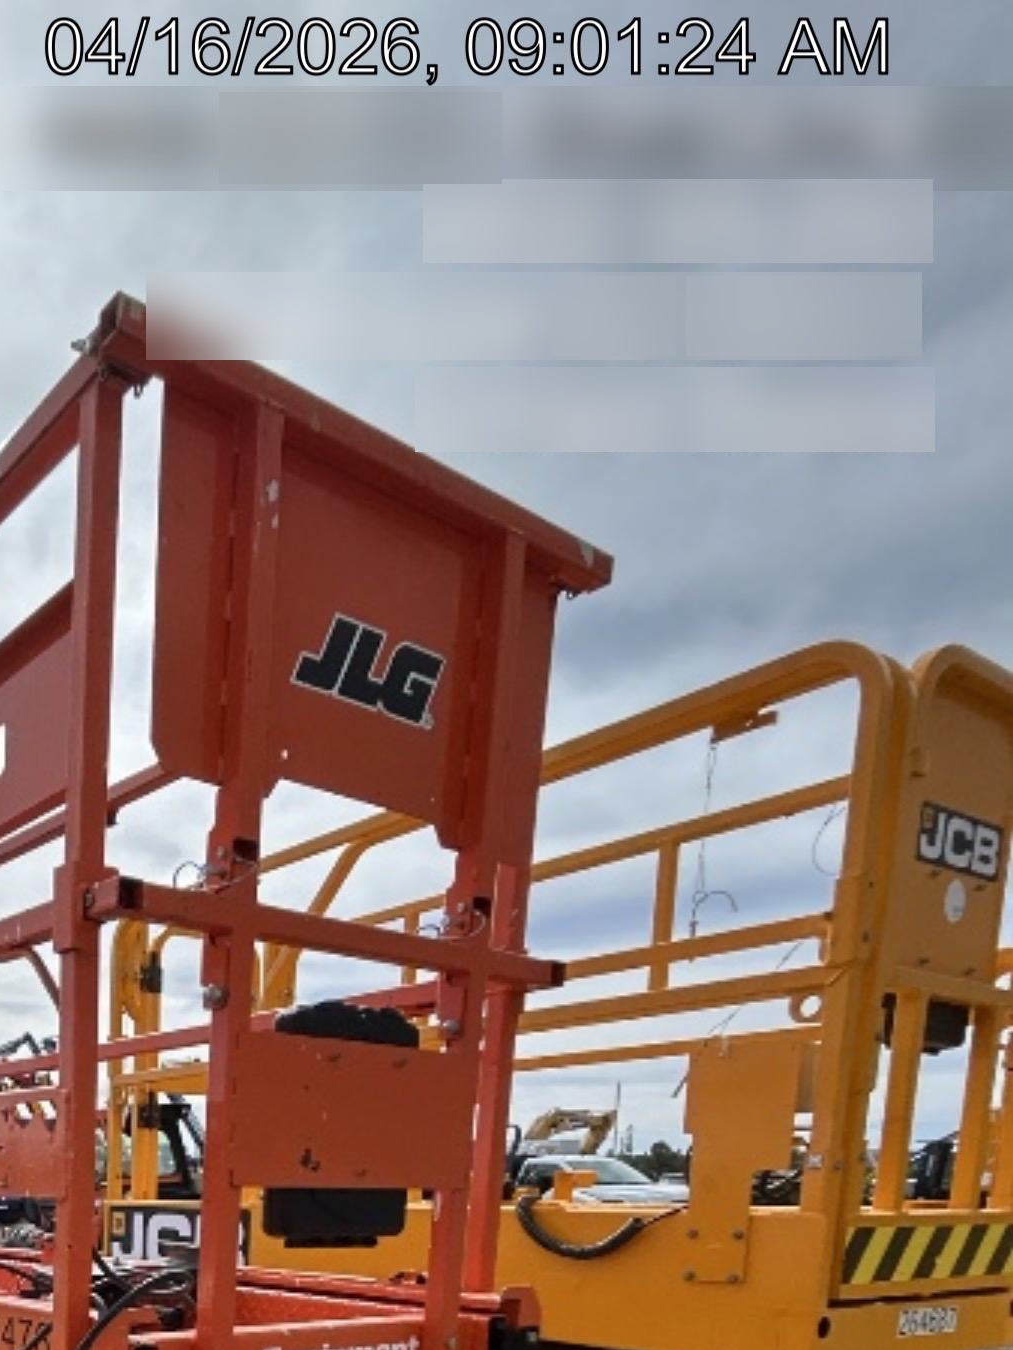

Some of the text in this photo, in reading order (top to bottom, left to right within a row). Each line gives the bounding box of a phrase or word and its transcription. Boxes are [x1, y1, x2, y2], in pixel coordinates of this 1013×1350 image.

[290, 612, 446, 729] JLG
[919, 811, 1000, 878] JCB
[111, 1211, 245, 1268] JC
